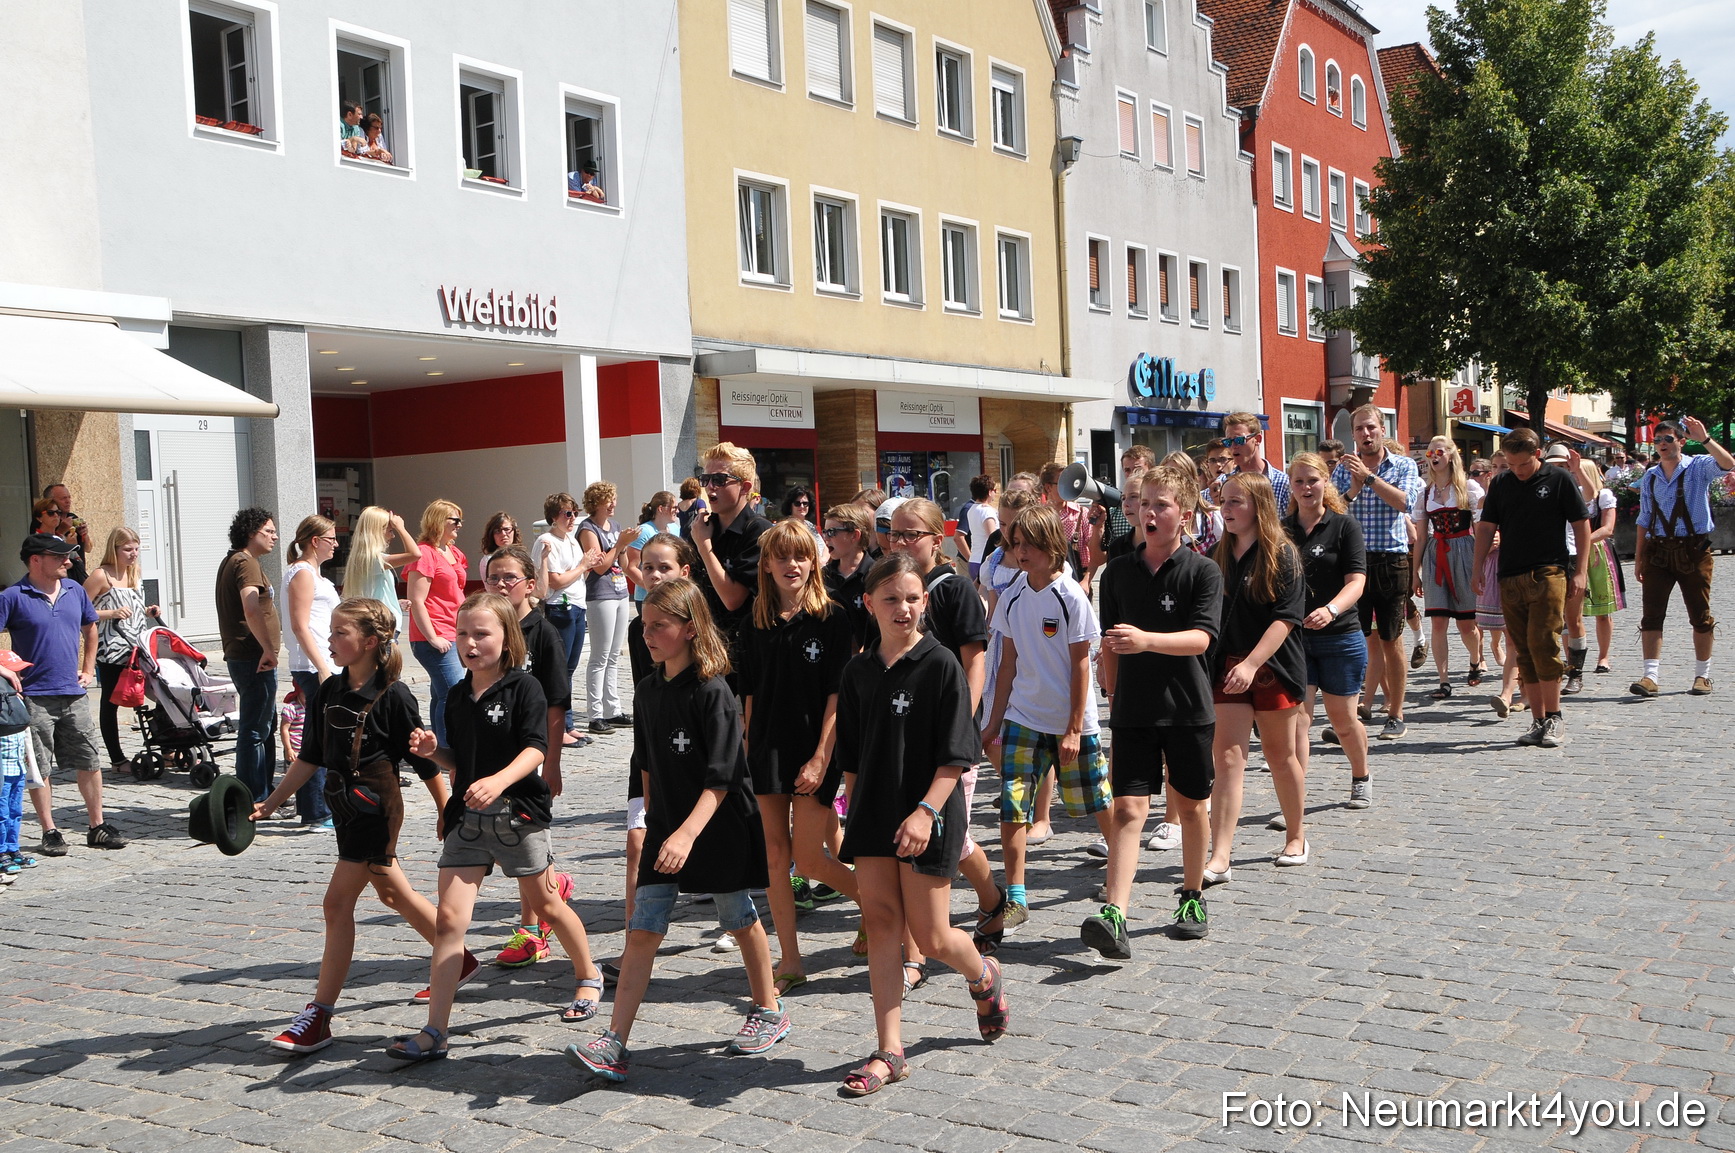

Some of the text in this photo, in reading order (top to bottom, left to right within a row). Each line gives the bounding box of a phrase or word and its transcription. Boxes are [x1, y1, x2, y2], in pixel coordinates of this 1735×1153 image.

[441, 285, 558, 331] Weltbild
[1132, 352, 1200, 400] Eilles
[731, 390, 789, 404] Reissinger Optik
[900, 401, 944, 413] Reissinger Optik
[769, 408, 802, 419] CENTRUM
[198, 419, 208, 431] 29
[929, 417, 955, 426] CENTRUM
